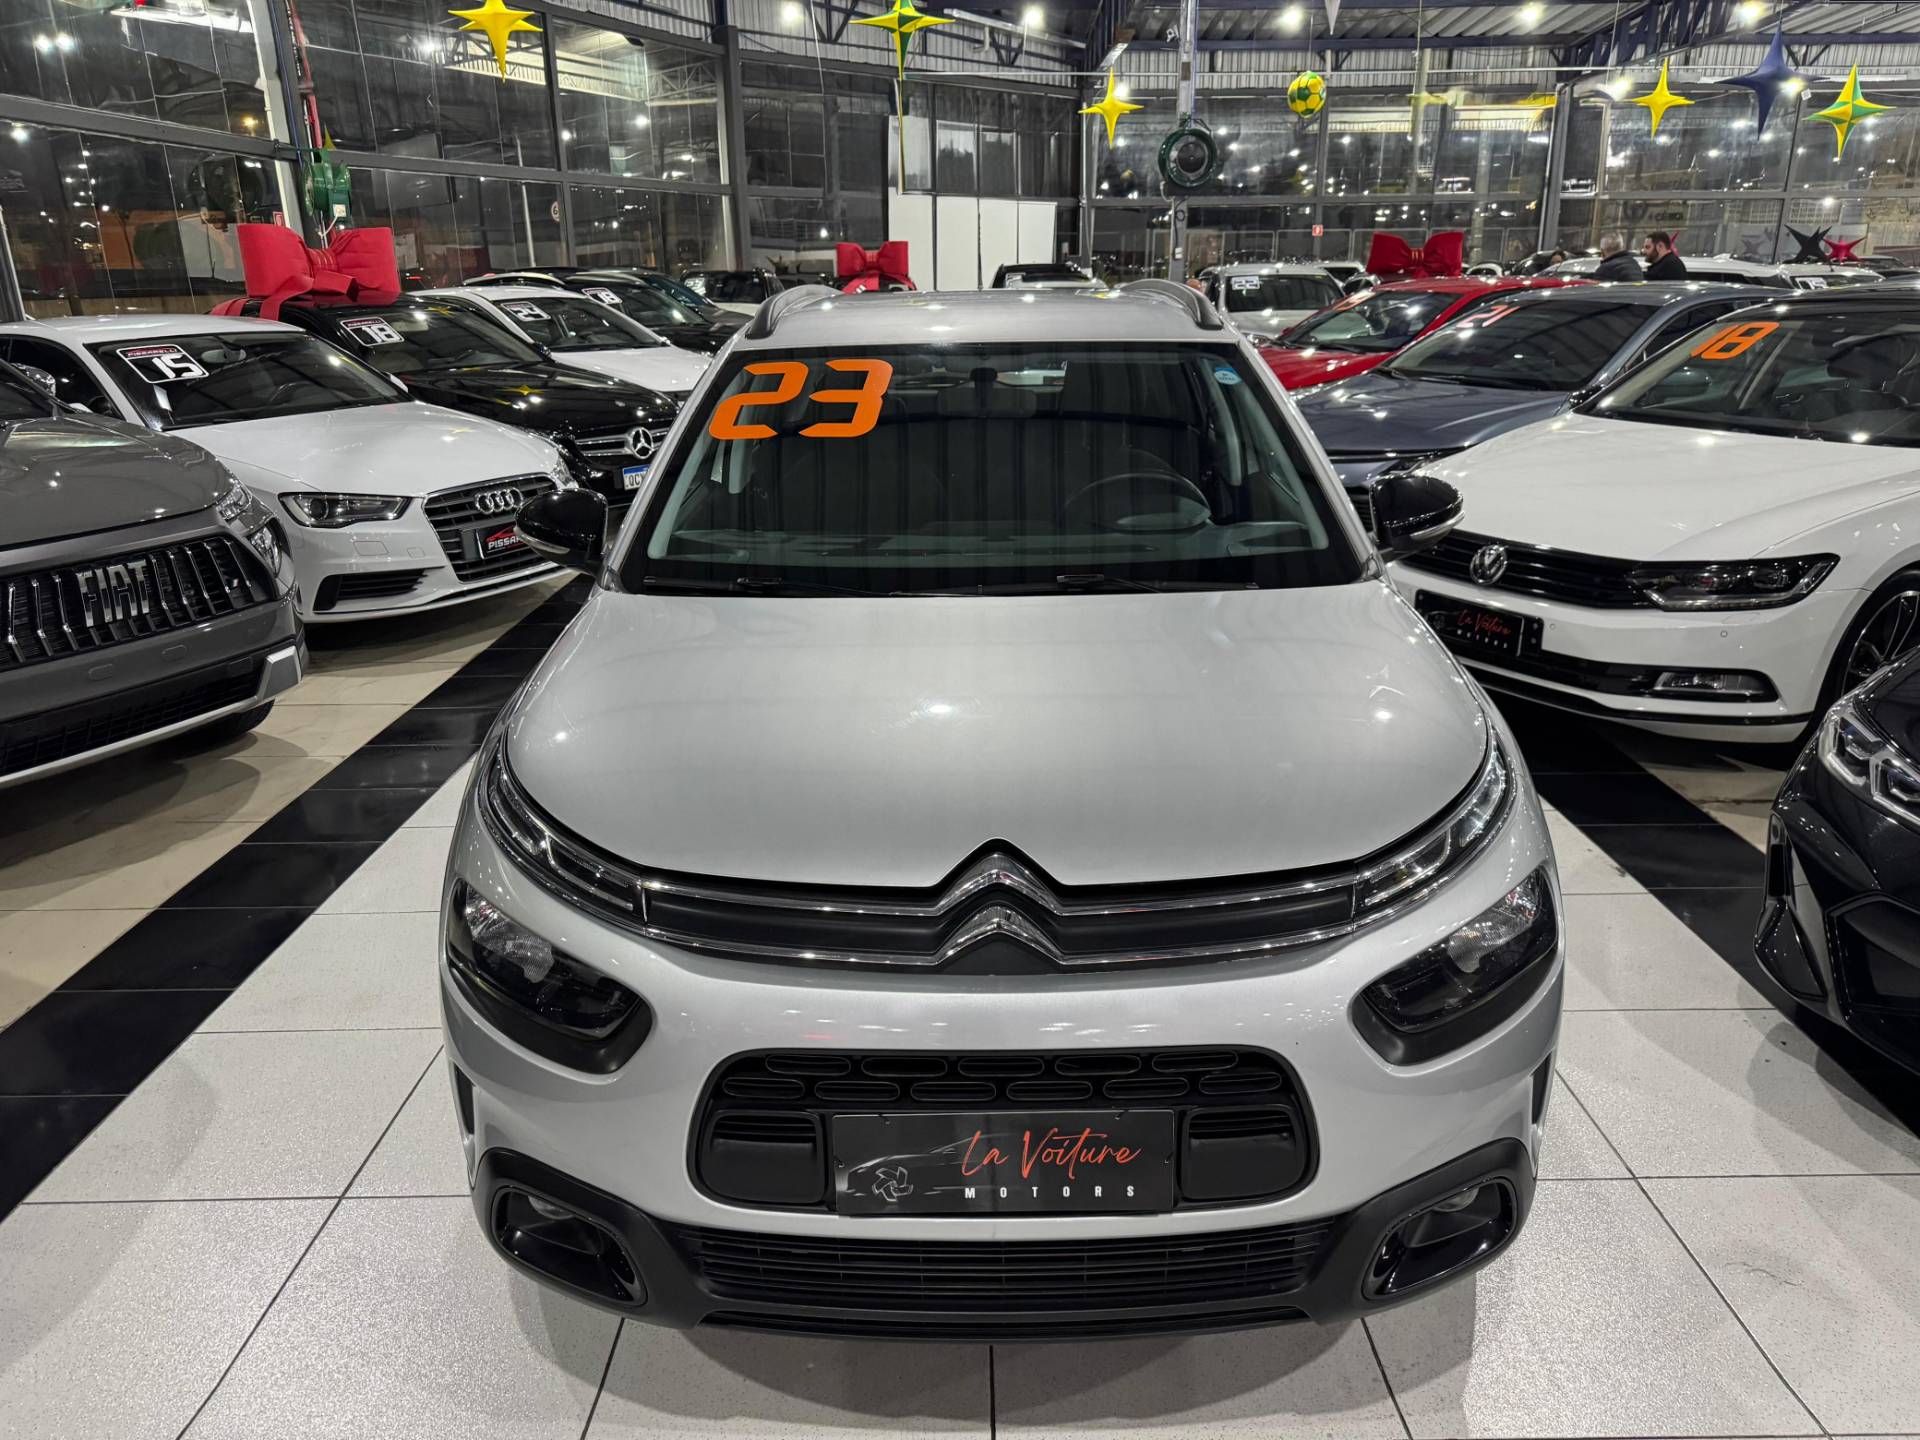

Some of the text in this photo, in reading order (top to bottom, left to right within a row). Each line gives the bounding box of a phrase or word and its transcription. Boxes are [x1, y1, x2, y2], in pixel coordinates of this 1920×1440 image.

[1456, 304, 1521, 328] 21
[361, 324, 402, 343] 18
[1690, 321, 1780, 360] 18
[151, 353, 204, 379] 15
[708, 358, 894, 441] 23
[75, 558, 150, 628] FIAT
[961, 1127, 1143, 1180] La Voiture
[964, 1185, 1136, 1199] MOTORS
